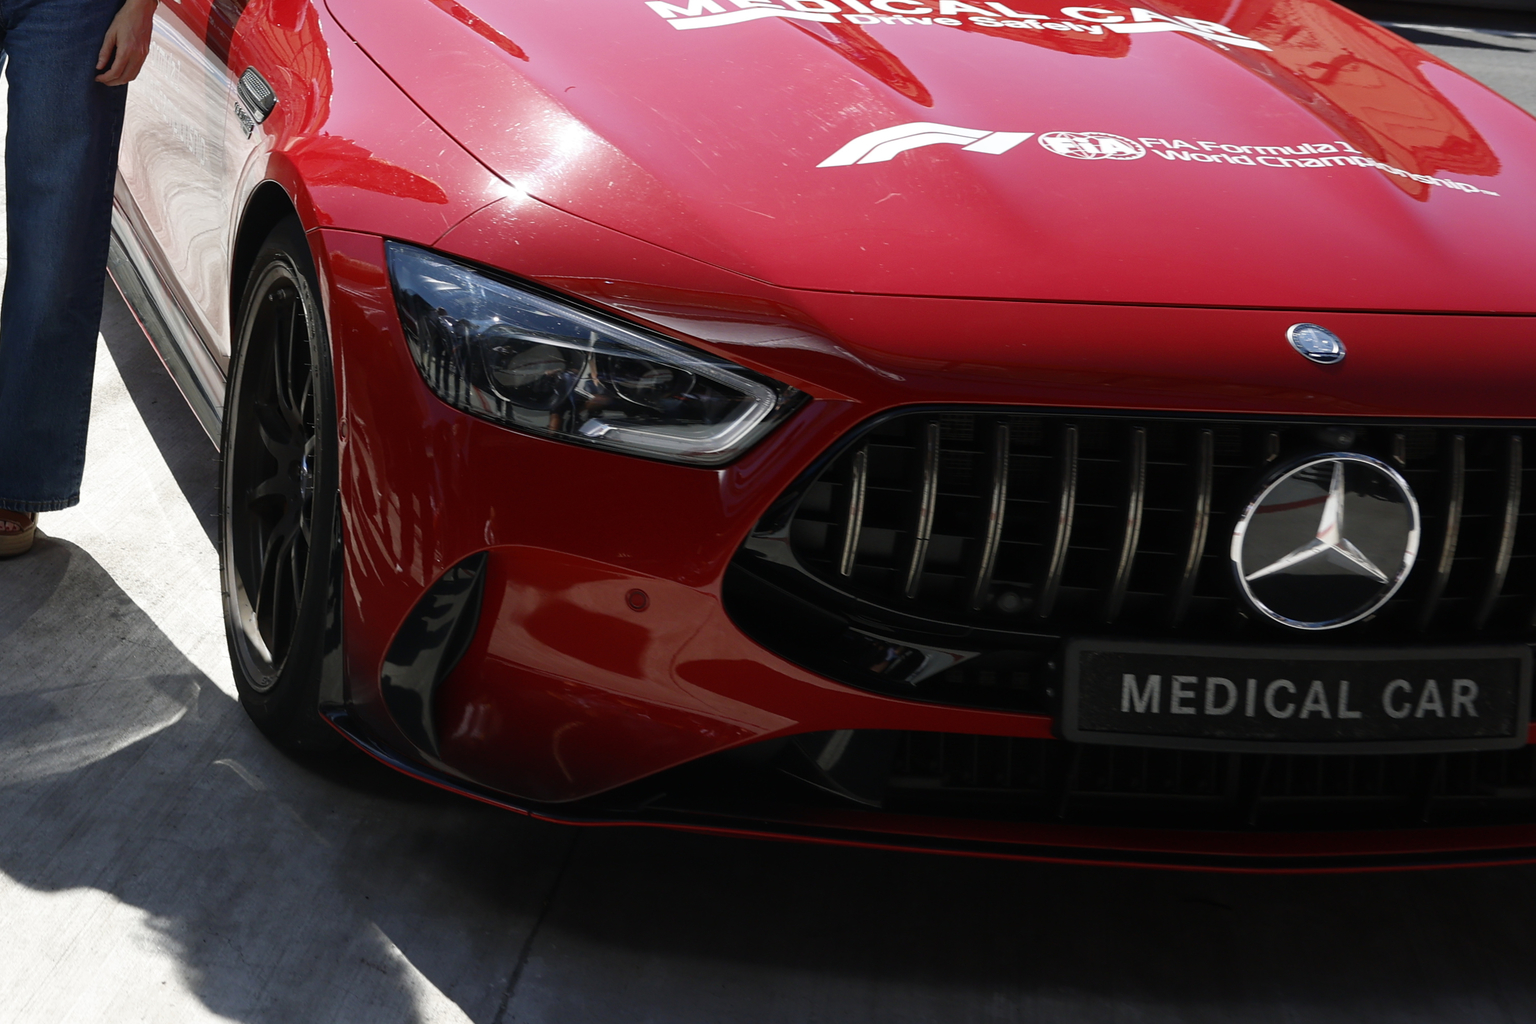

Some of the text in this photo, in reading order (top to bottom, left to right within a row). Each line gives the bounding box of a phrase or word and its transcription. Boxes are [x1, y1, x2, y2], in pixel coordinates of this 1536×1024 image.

[842, 13, 1104, 35] Drive Safely
[1061, 6, 1252, 41] CAR
[1137, 137, 1205, 152] FIA
[1205, 139, 1338, 155] Formula
[1150, 149, 1482, 194] World Championship
[1121, 673, 1480, 720] MEDICAL CAR
